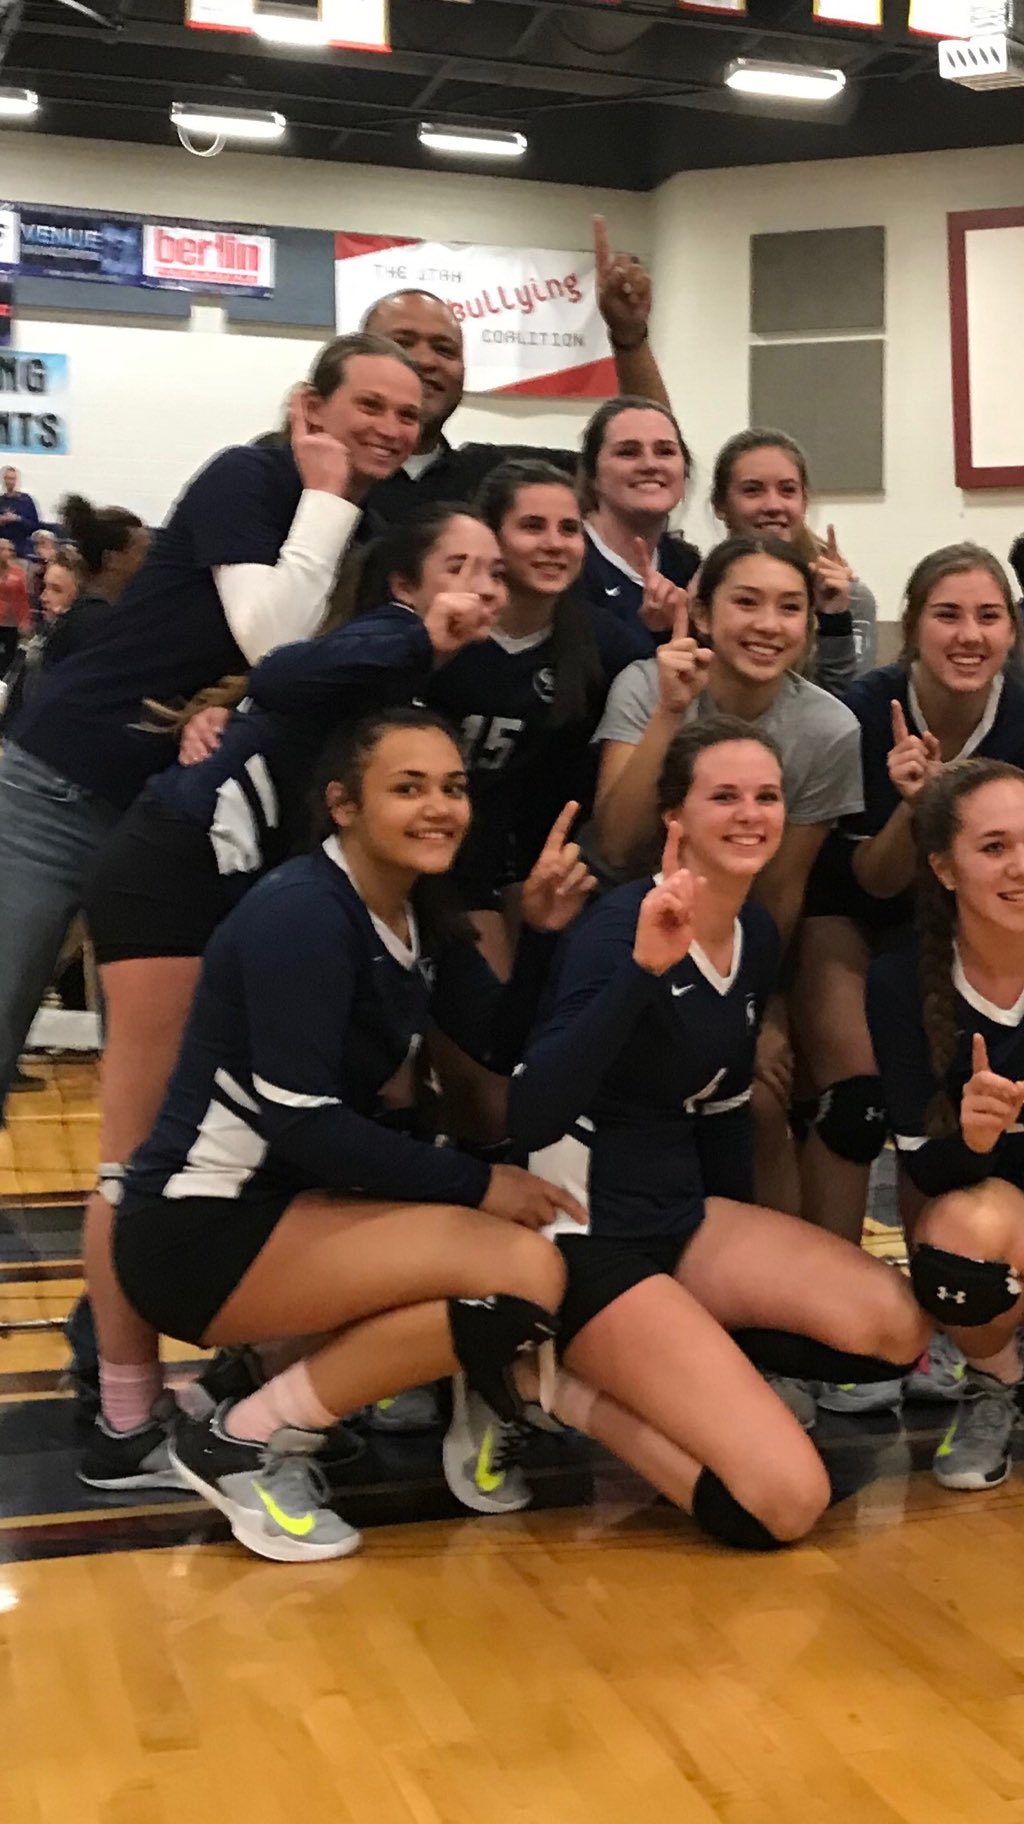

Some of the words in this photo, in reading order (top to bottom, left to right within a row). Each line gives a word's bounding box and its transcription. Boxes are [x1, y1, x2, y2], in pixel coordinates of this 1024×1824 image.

[153, 227, 260, 272] berlin
[373, 263, 408, 280] THE
[482, 328, 586, 347] COALITION
[461, 714, 525, 770] 15
